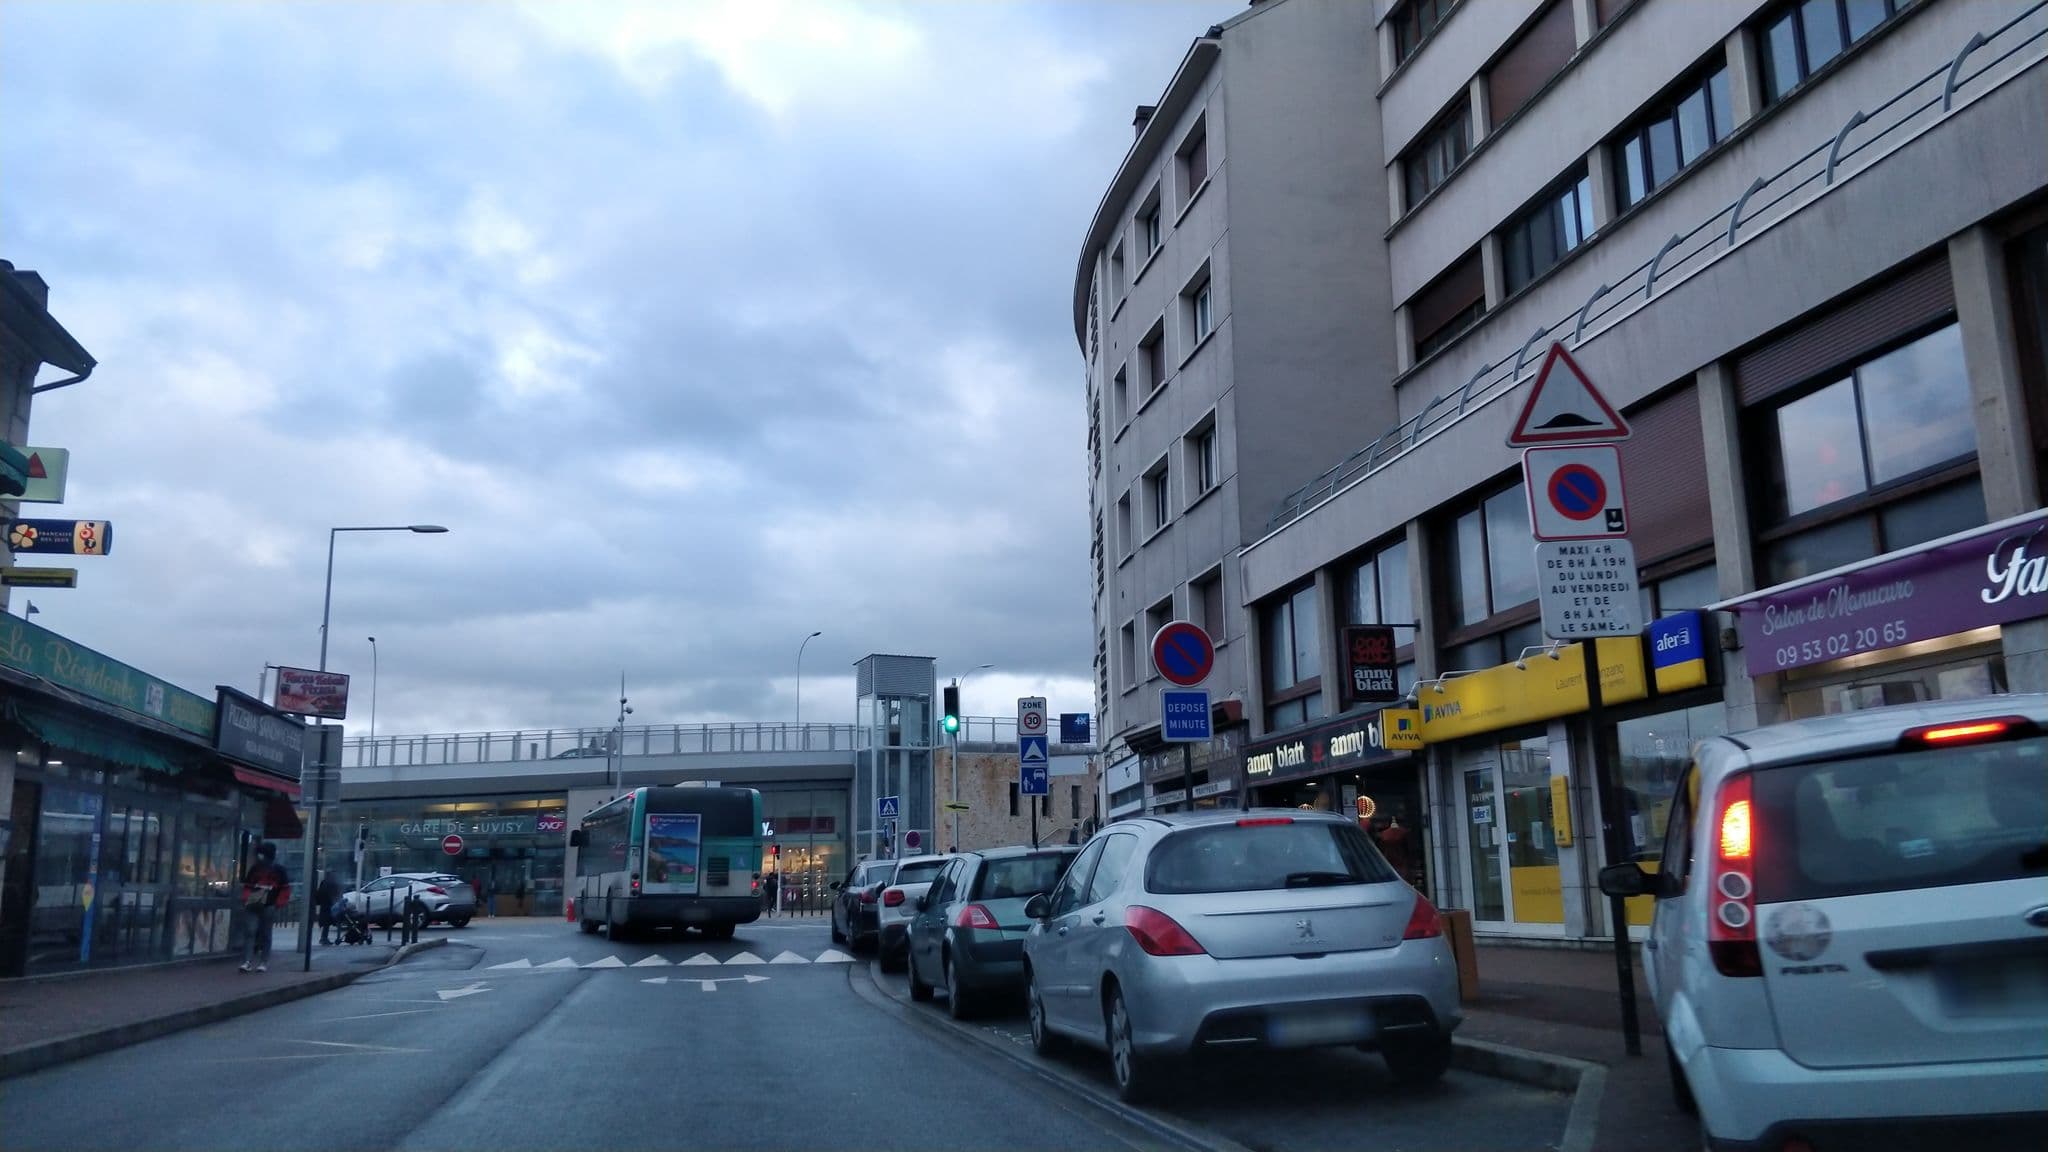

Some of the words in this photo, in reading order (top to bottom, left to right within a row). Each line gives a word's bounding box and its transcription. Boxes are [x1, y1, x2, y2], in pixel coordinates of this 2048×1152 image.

[1559, 546, 1589, 555] MAXI
[1547, 560, 1563, 568] DE
[1568, 559, 1585, 568] 8H
[1590, 556, 1597, 567] À
[1602, 557, 1626, 566] 19H
[1559, 572, 1575, 581] DU
[1580, 570, 1618, 580] LUNDI
[1552, 585, 1566, 594] AU
[1571, 583, 1629, 593] VENDREDI
[1574, 597, 1587, 606] ET
[1594, 596, 1610, 605] DE
[1762, 604, 1805, 636] Salon
[1808, 596, 1826, 621] de
[1827, 579, 1914, 620] Manucure
[1563, 610, 1580, 619] 8H
[1587, 608, 1594, 618] À
[1561, 624, 1575, 632] LE
[1656, 632, 1680, 652] afer
[1776, 646, 1798, 666] 09
[1802, 640, 1821, 660] 53
[1827, 634, 1848, 655] 02
[1856, 628, 1877, 649] 20
[1883, 620, 1907, 642] 65
[283, 672, 314, 684] Tacos
[1353, 668, 1393, 680] anny
[1356, 679, 1394, 691] blatt
[1022, 701, 1042, 709] ZONE
[1167, 703, 1206, 713] DEPOSE
[1435, 701, 1462, 719] AVIVA
[1027, 716, 1038, 725] 30
[1169, 719, 1206, 729] MINUTE
[1247, 752, 1274, 776] anny
[1276, 740, 1306, 768] blatt
[1330, 729, 1364, 757] anny
[400, 823, 440, 834] GARE
[447, 823, 465, 833] DE
[537, 821, 564, 831] SNCF
